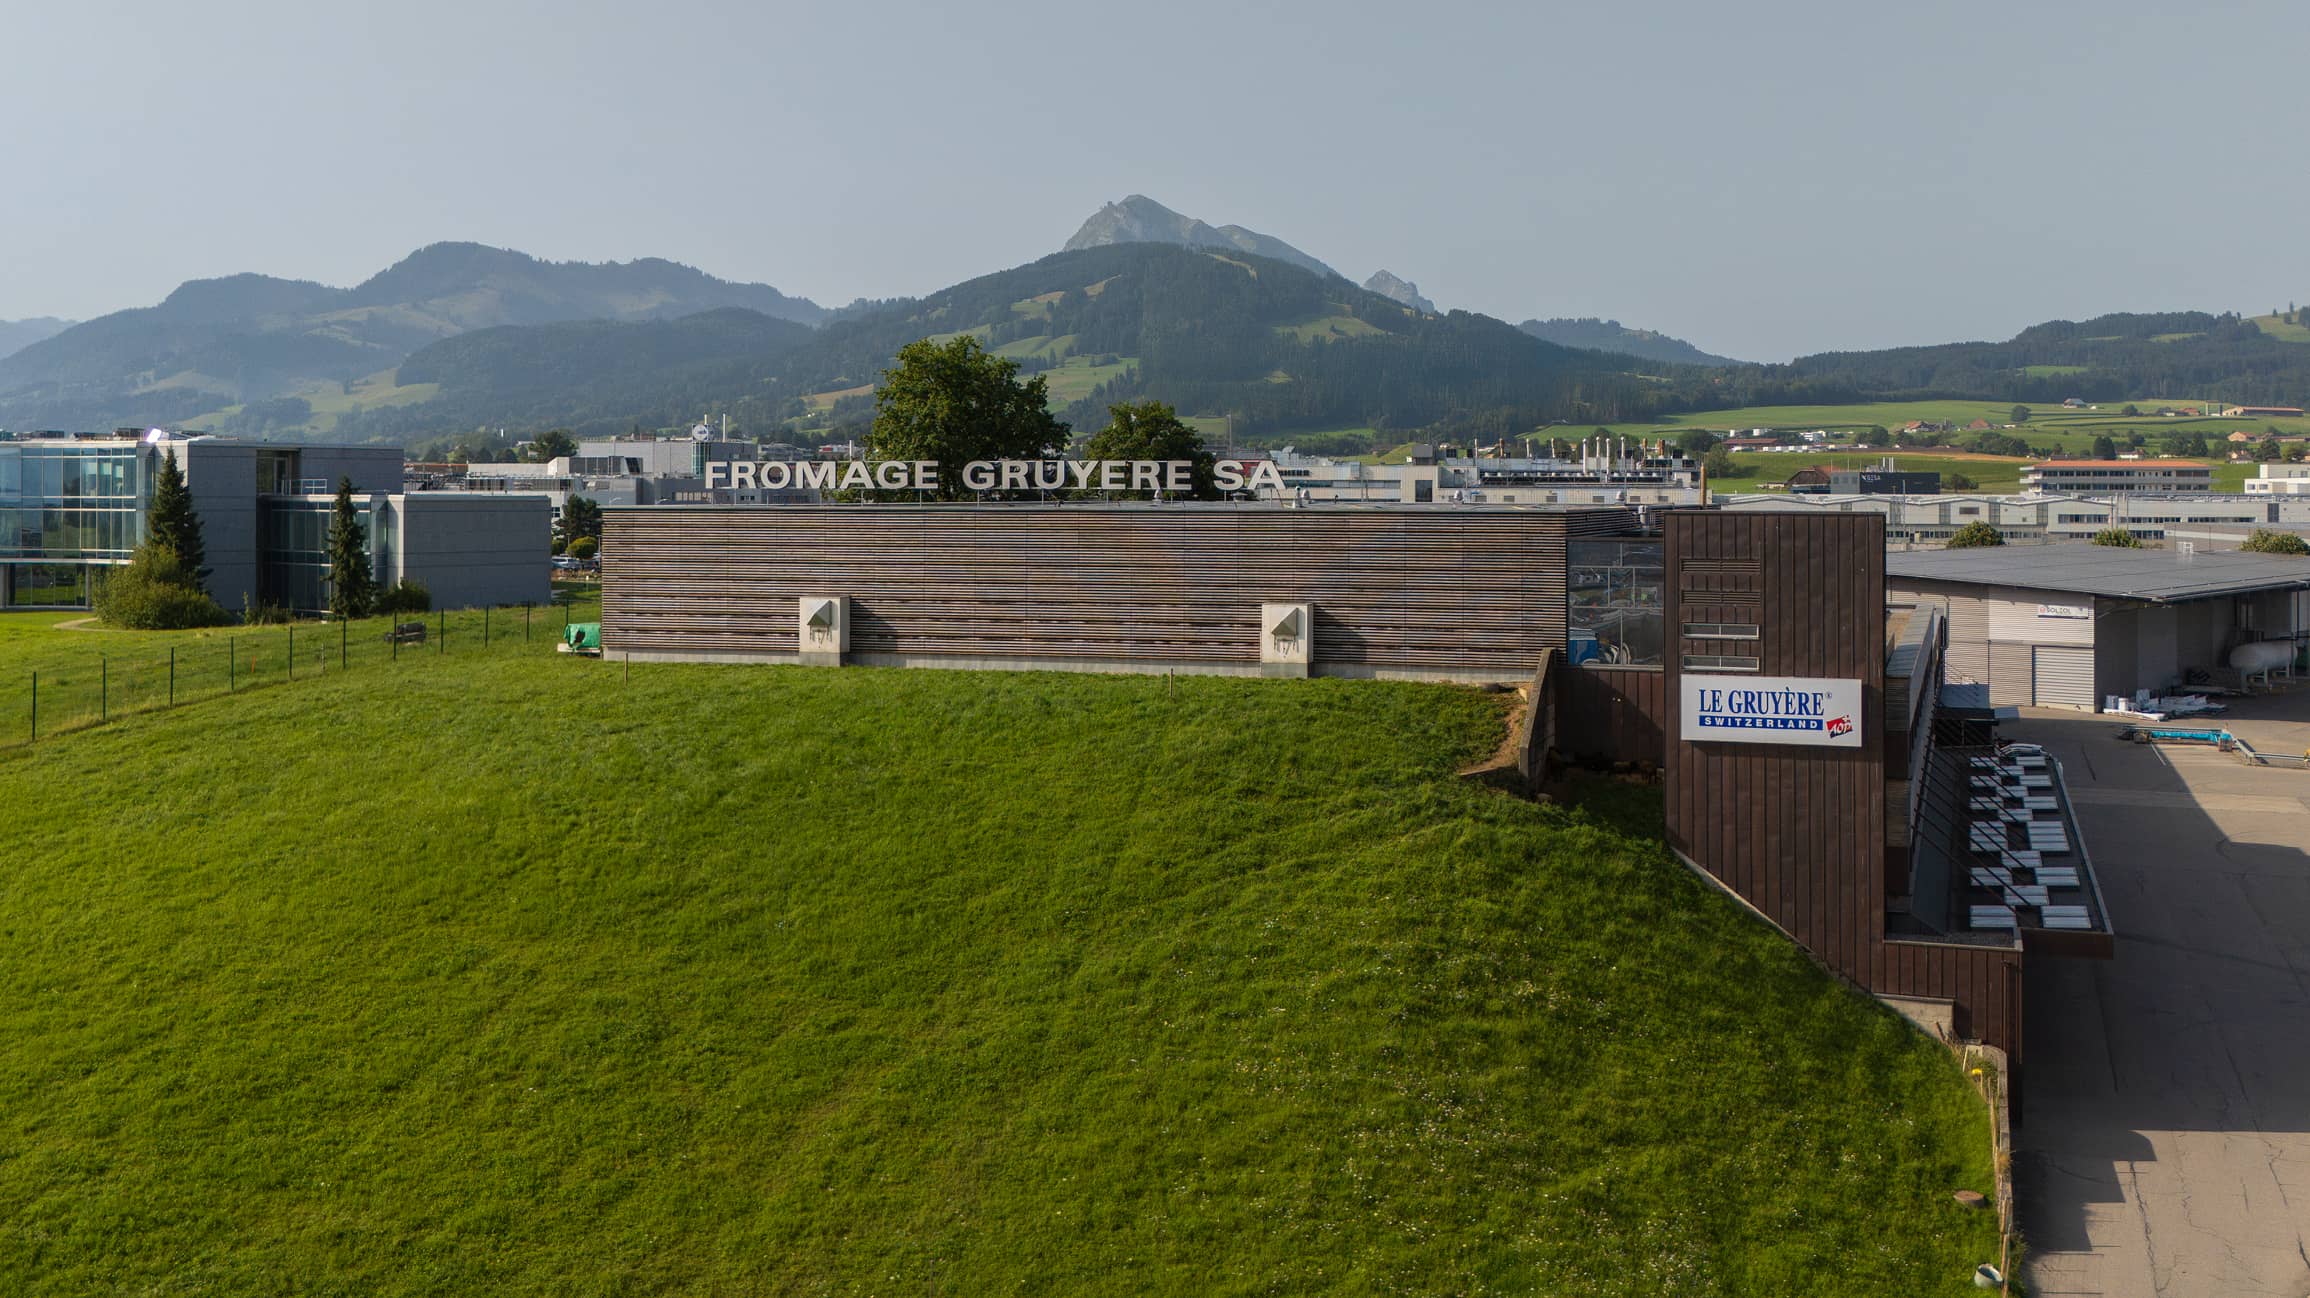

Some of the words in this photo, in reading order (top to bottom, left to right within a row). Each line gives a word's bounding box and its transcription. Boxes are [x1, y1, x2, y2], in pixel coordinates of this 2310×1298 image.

[705, 461, 939, 489] FROMAGE
[962, 460, 1192, 490] GRUYERE
[1213, 460, 1286, 490] SA
[1699, 689, 1723, 713] LE
[1704, 718, 1818, 729] SWITZERLAND
